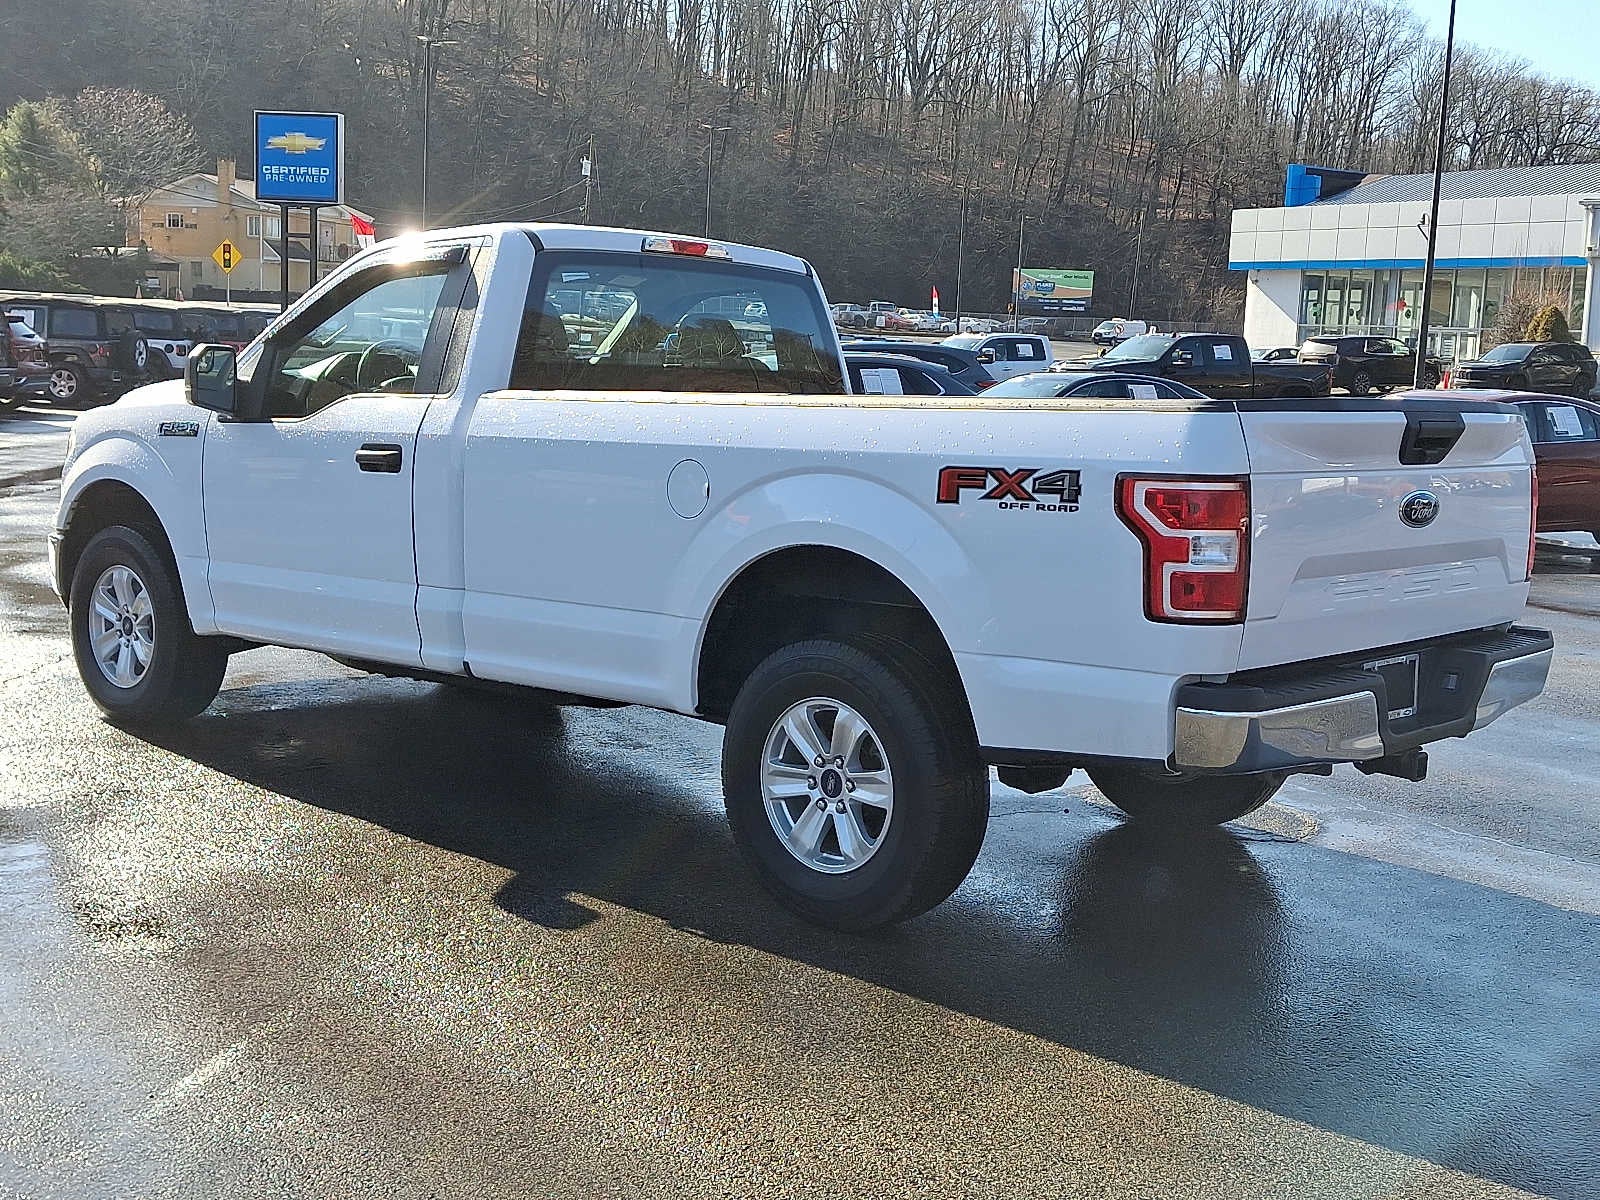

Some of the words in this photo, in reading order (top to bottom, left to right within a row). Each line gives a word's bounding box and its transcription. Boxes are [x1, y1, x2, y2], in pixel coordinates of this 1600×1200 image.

[262, 165, 330, 176] CERTIFIED
[265, 174, 327, 184] PRE-OWNED
[936, 465, 1082, 505] FX4
[998, 501, 1030, 511] OFF
[1035, 503, 1080, 513] ROAD
